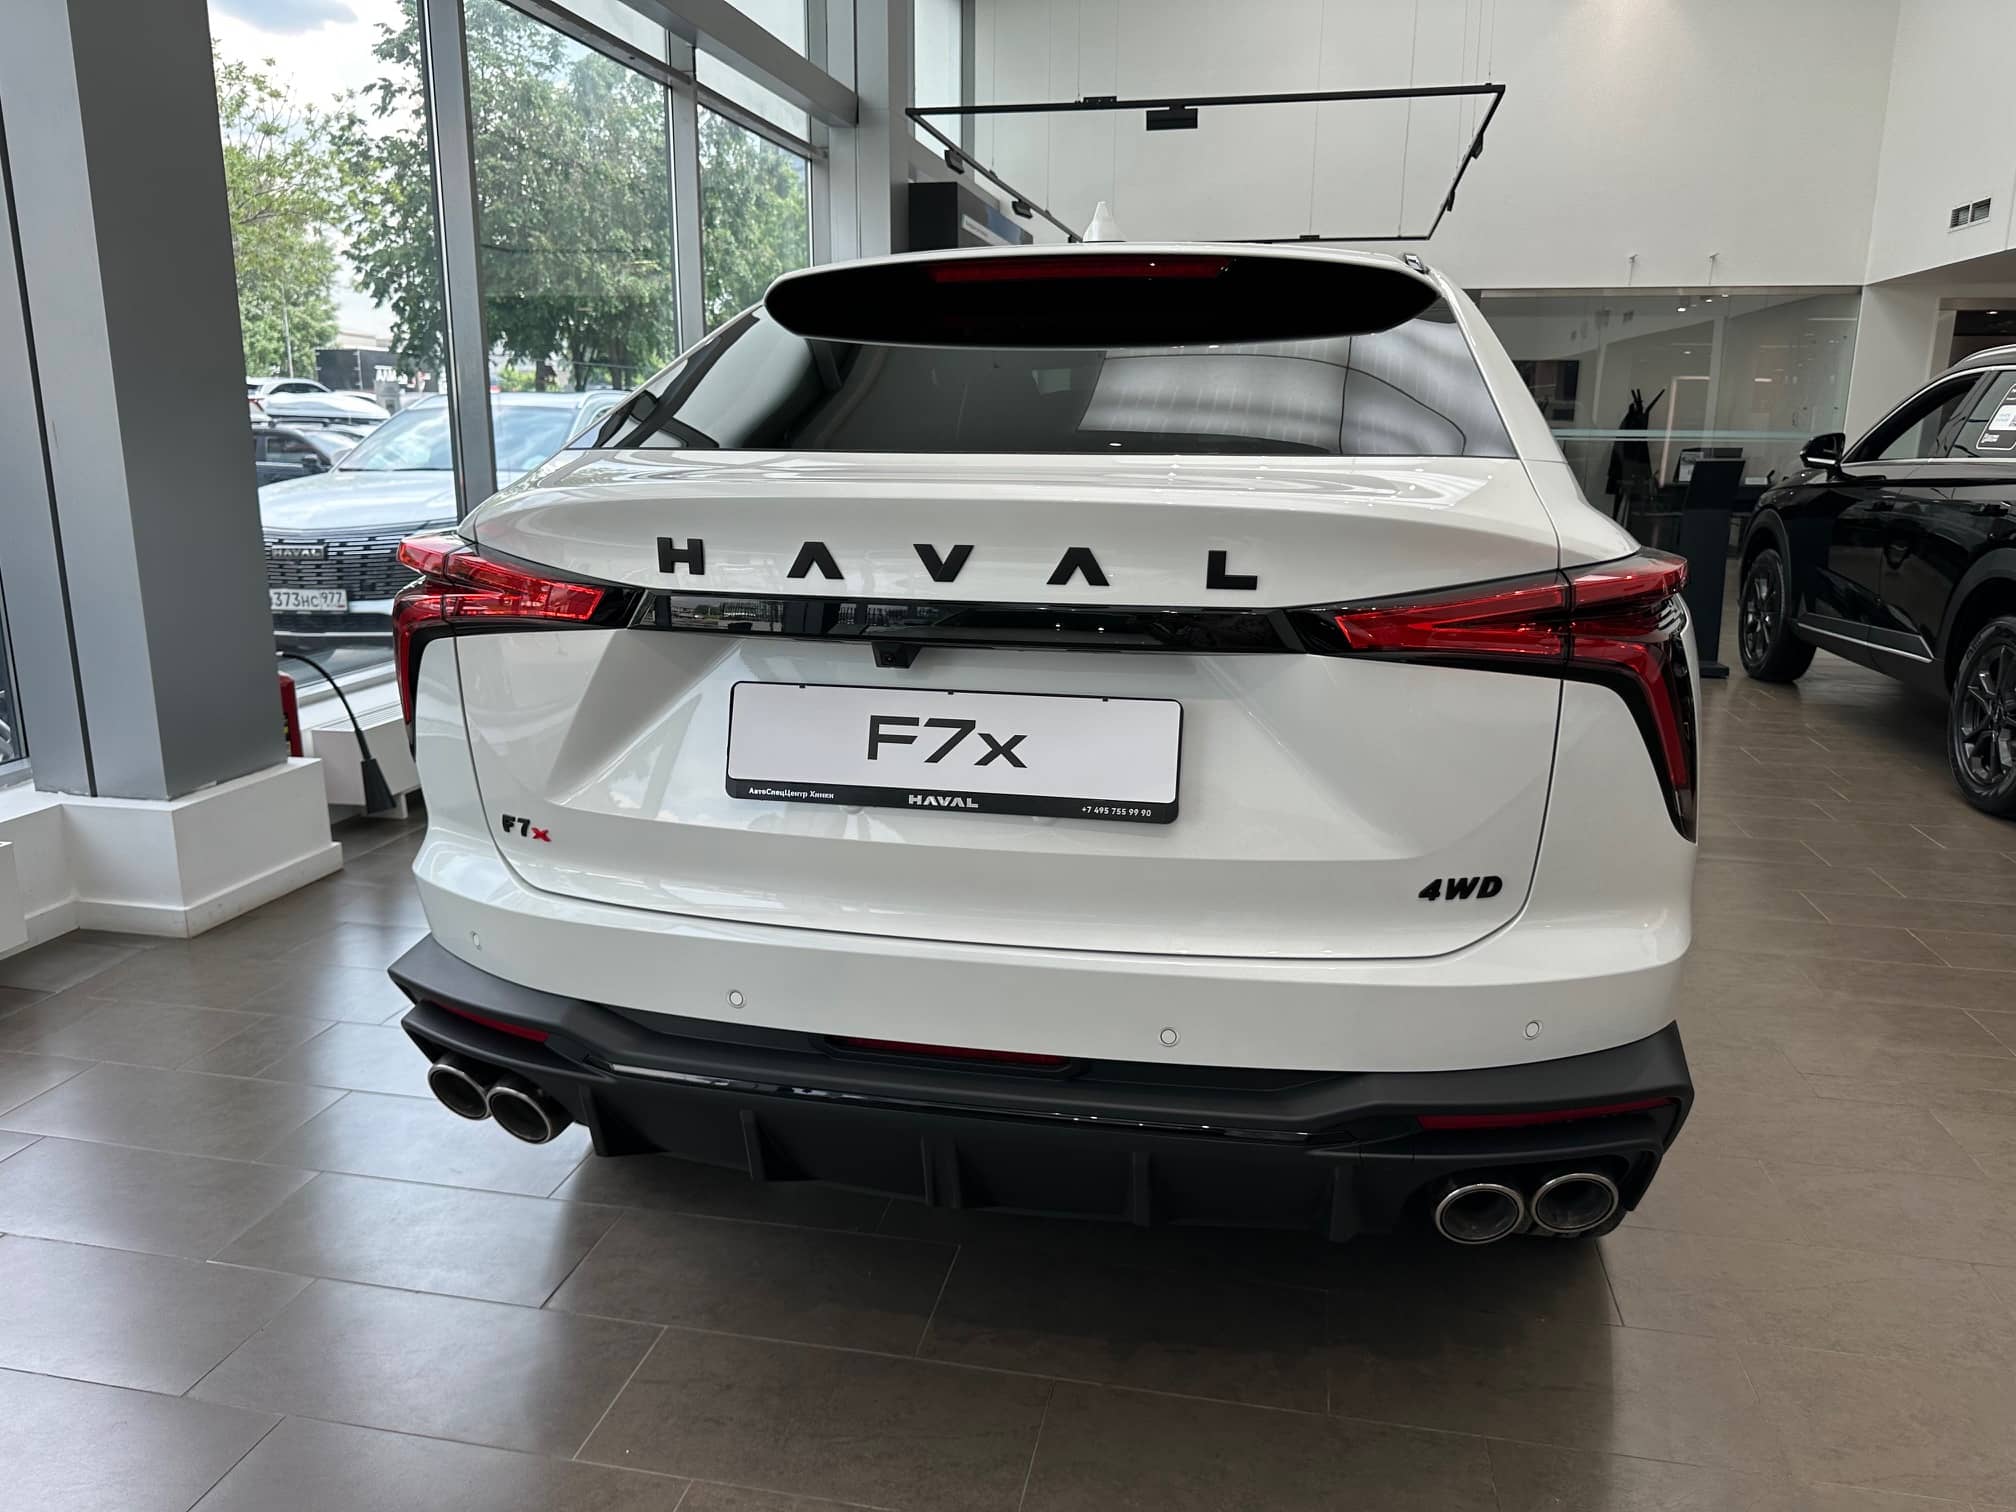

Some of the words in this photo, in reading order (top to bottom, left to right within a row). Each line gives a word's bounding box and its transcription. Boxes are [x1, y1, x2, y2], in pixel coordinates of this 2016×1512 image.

[656, 536, 1258, 590] HAVAL
[908, 794, 979, 809] HAVAL
[1082, 806, 1092, 814] +7
[1093, 806, 1109, 815] 495
[1111, 807, 1127, 816] 755
[1128, 808, 1139, 817] 99
[1140, 809, 1152, 817] 90
[1418, 876, 1503, 901] 4WD
